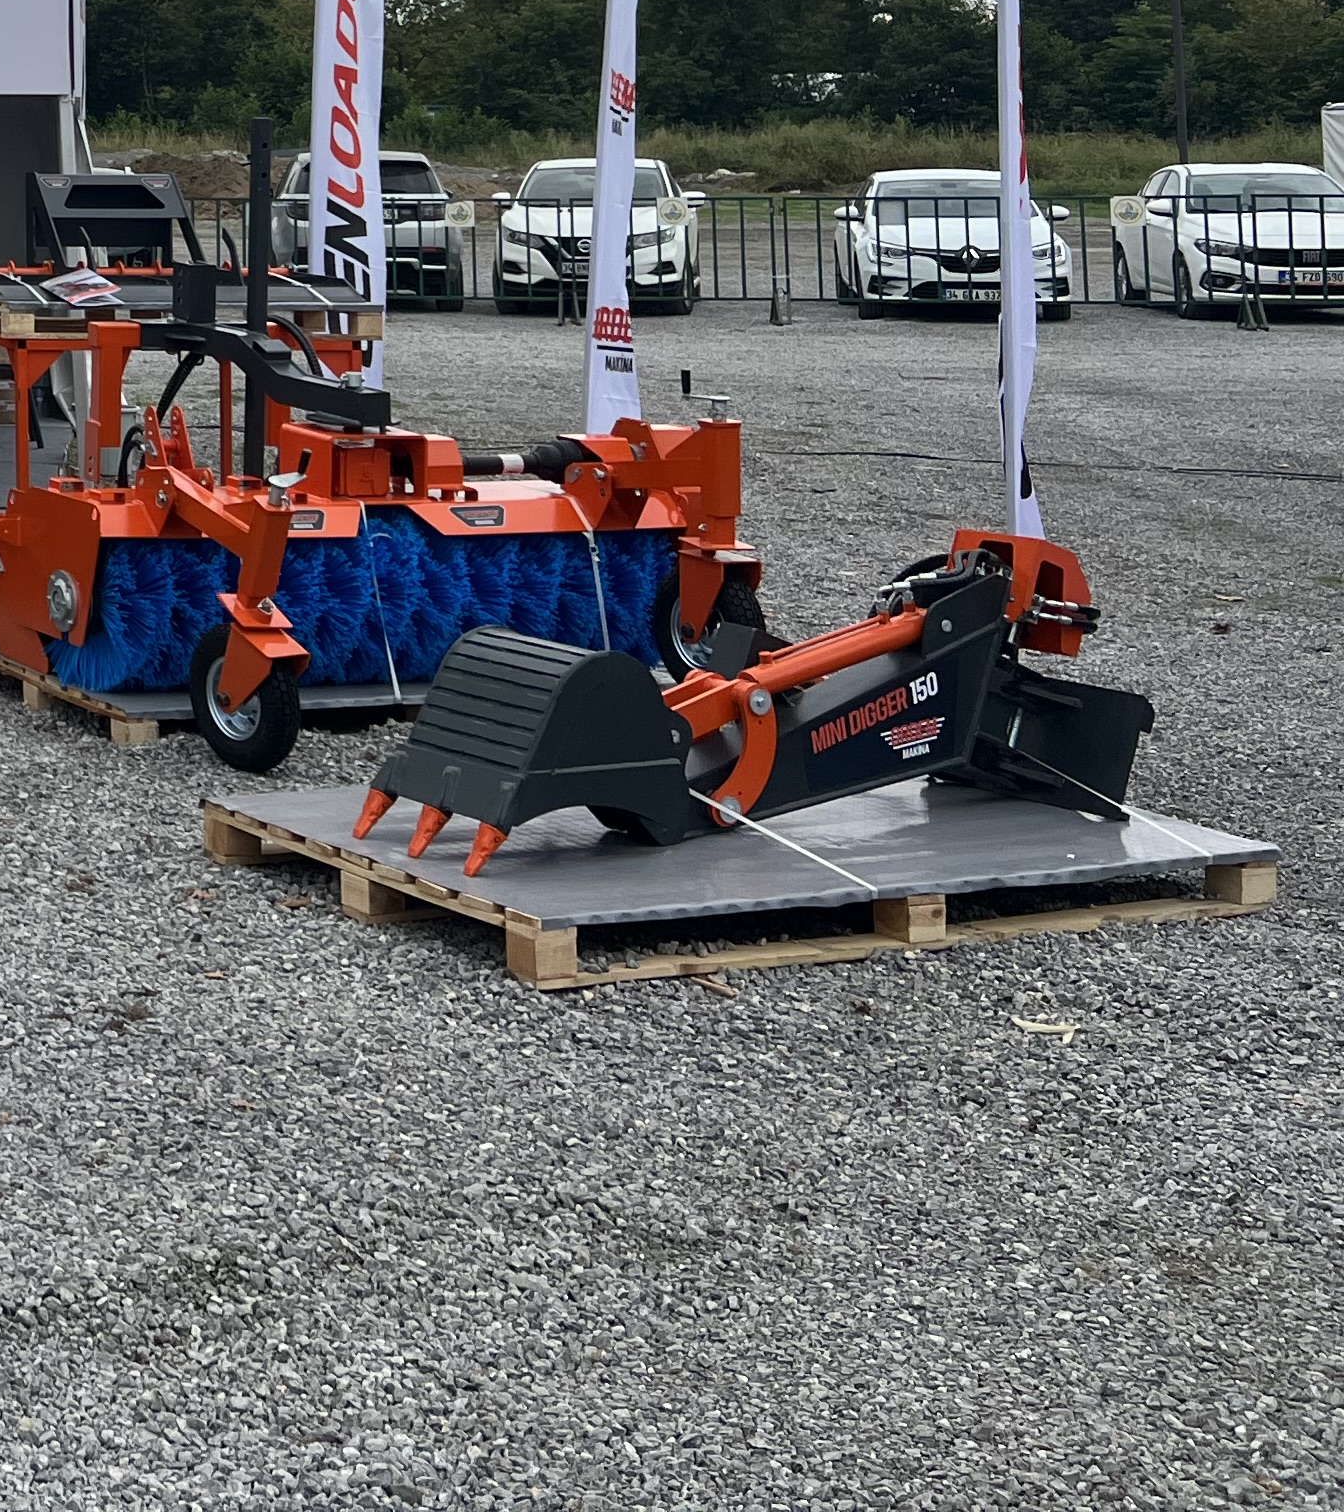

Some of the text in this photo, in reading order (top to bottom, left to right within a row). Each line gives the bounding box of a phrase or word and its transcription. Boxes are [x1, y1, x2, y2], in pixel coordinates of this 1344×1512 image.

[1303, 251, 1320, 263] FIAT
[947, 291, 958, 299] 34
[962, 291, 980, 300] GA
[811, 671, 939, 754] MINI DIGGER 150
